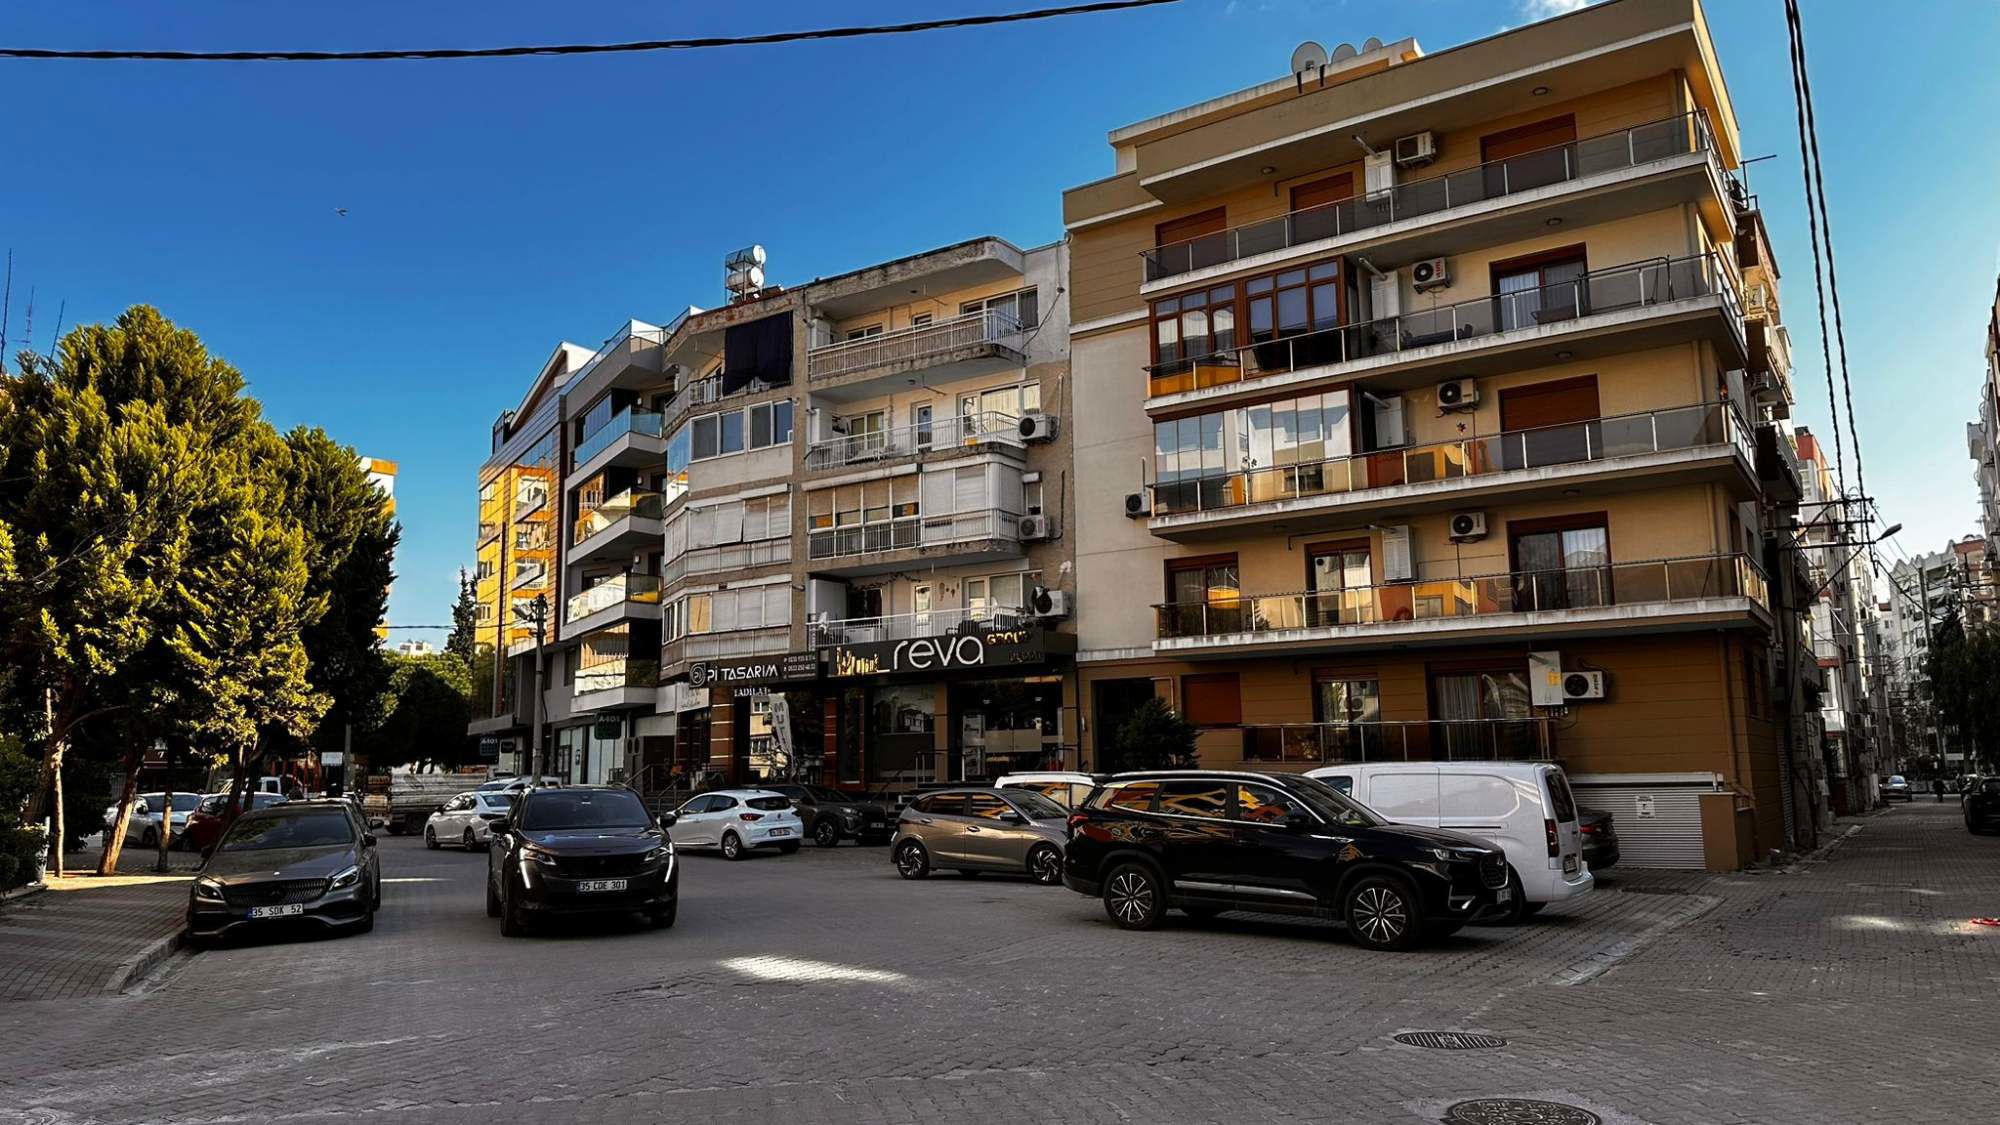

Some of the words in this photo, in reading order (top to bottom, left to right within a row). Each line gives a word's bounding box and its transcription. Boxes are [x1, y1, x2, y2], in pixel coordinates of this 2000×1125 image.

[893, 636, 984, 670] reva
[720, 664, 778, 681] TASARIM
[582, 883, 591, 891] 35
[252, 907, 263, 917] 35
[290, 904, 302, 913] 52
